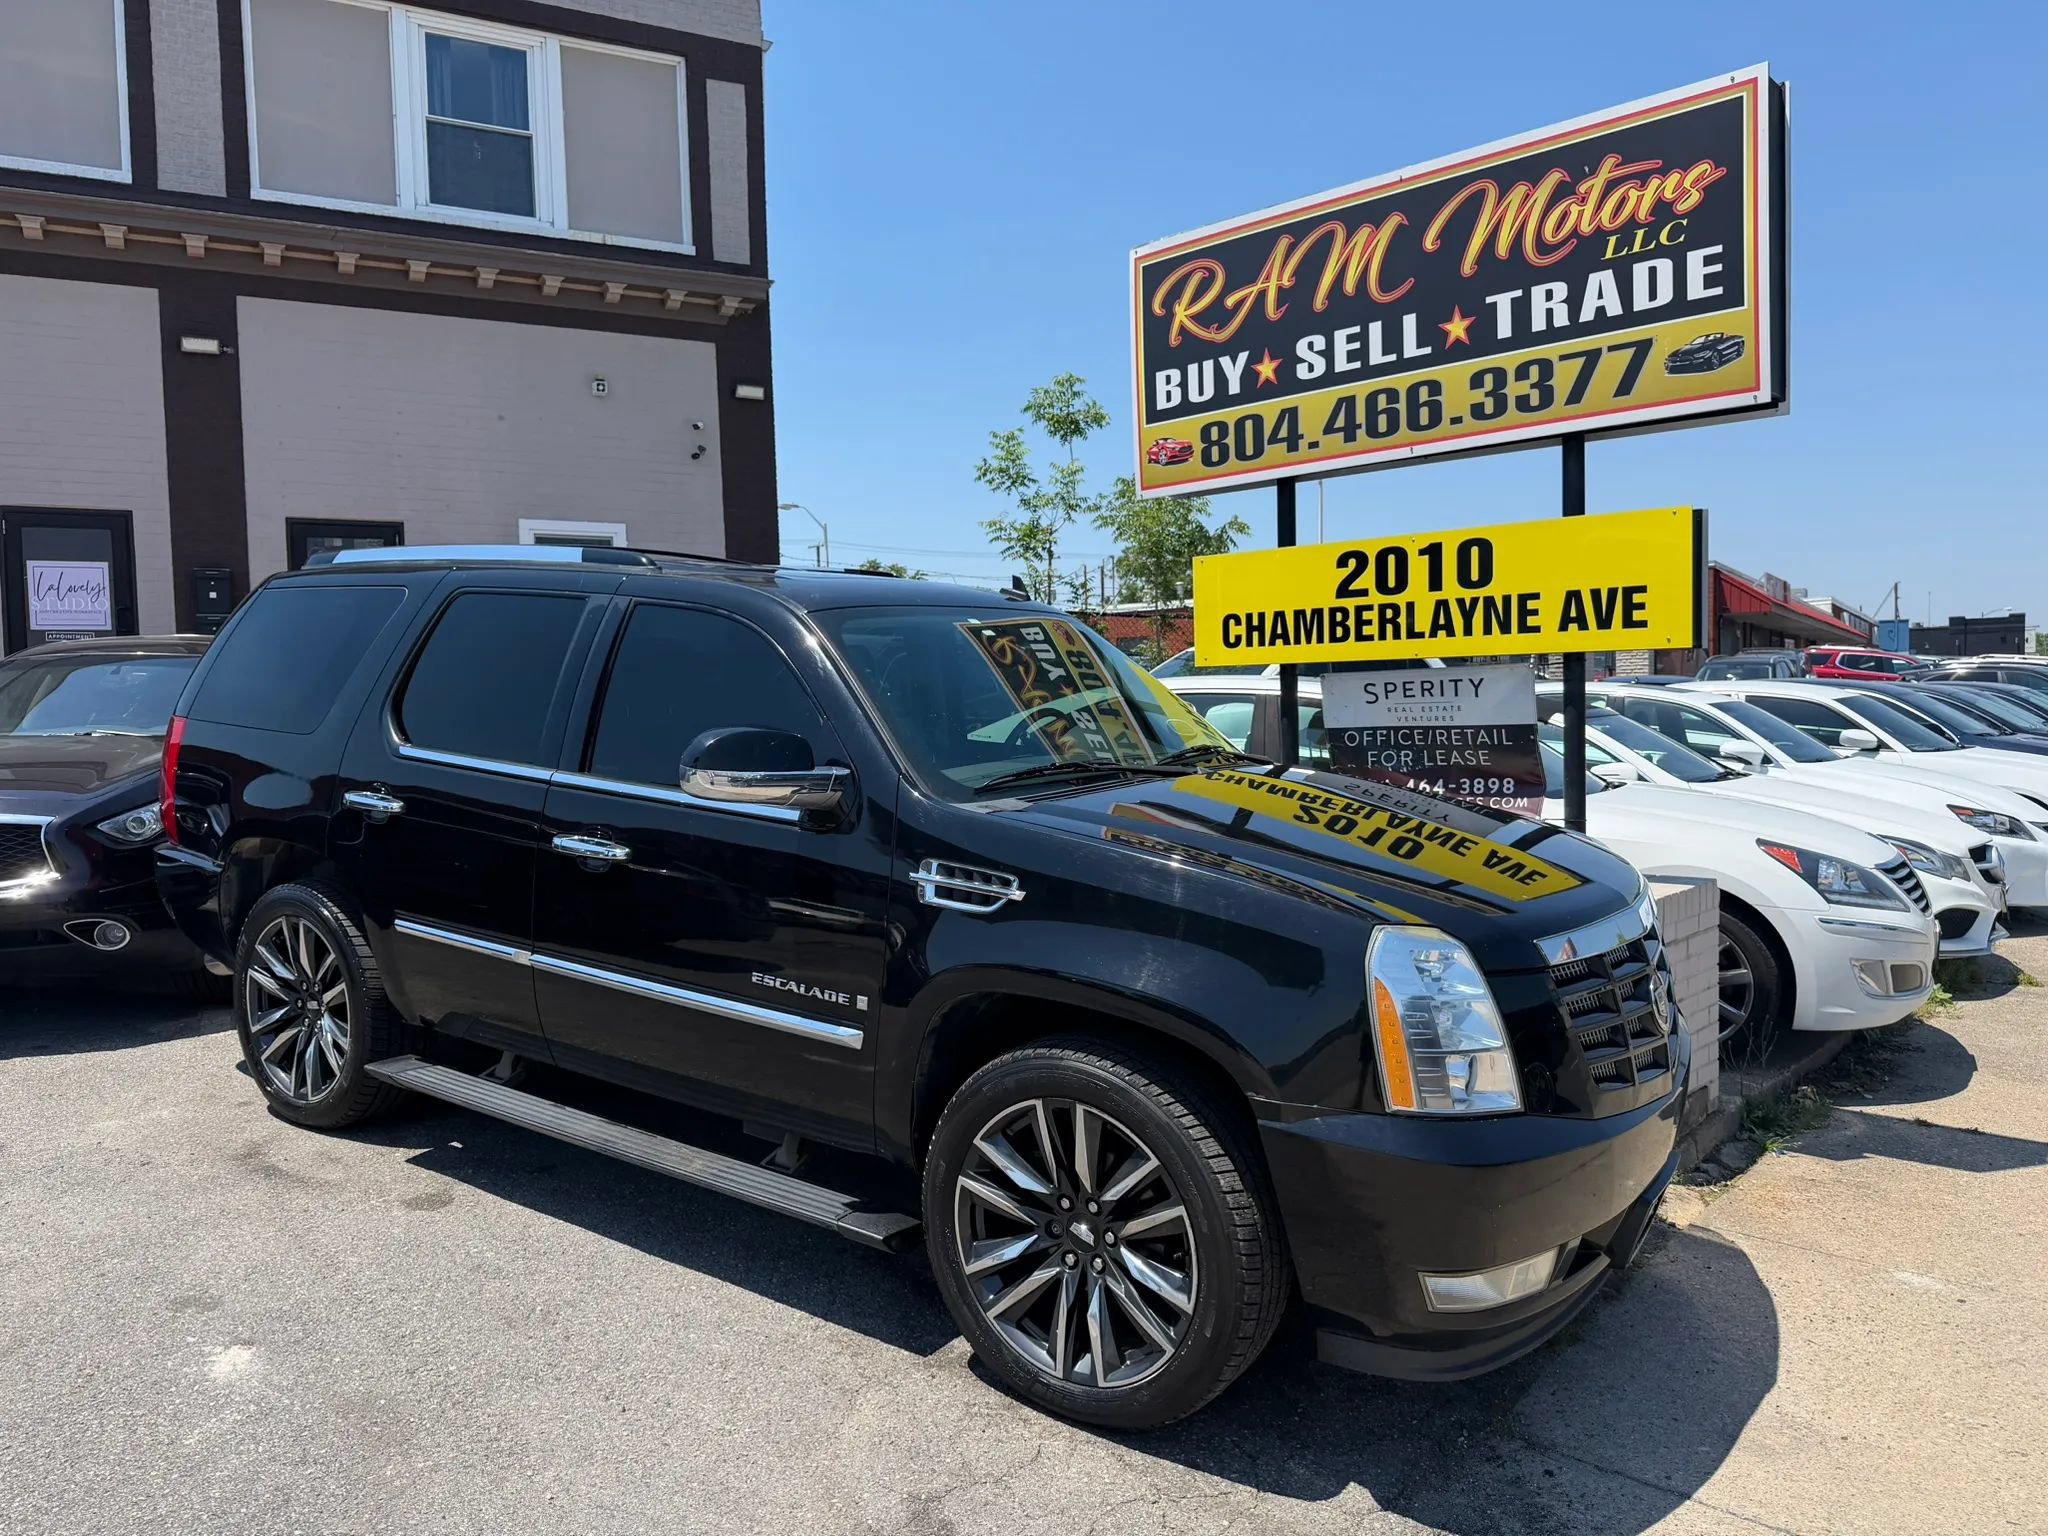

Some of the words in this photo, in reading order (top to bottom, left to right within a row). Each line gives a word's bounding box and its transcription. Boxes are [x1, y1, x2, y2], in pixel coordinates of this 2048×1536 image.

[1151, 211, 1415, 347] RAM
[1422, 153, 1727, 277] Motors
[1600, 219, 1689, 260] LLC
[1155, 350, 1250, 411] BUY
[1295, 313, 1433, 381] SELL
[1485, 244, 1724, 340] TRADE
[1198, 337, 1656, 469] 804.466.3377
[1334, 537, 1494, 600] 2010
[1221, 591, 1541, 650] CHAMBERLAYNE
[1558, 585, 1649, 633] AVE
[1363, 677, 1485, 704] SPERITY
[1387, 705, 1414, 713] REAL
[1421, 704, 1463, 712] ESTATE
[1344, 728, 1513, 747] OFFICE/RETAIL
[1367, 750, 1413, 767] FOR
[1424, 749, 1492, 766] LEASE
[751, 971, 850, 1006] ESCALADE
